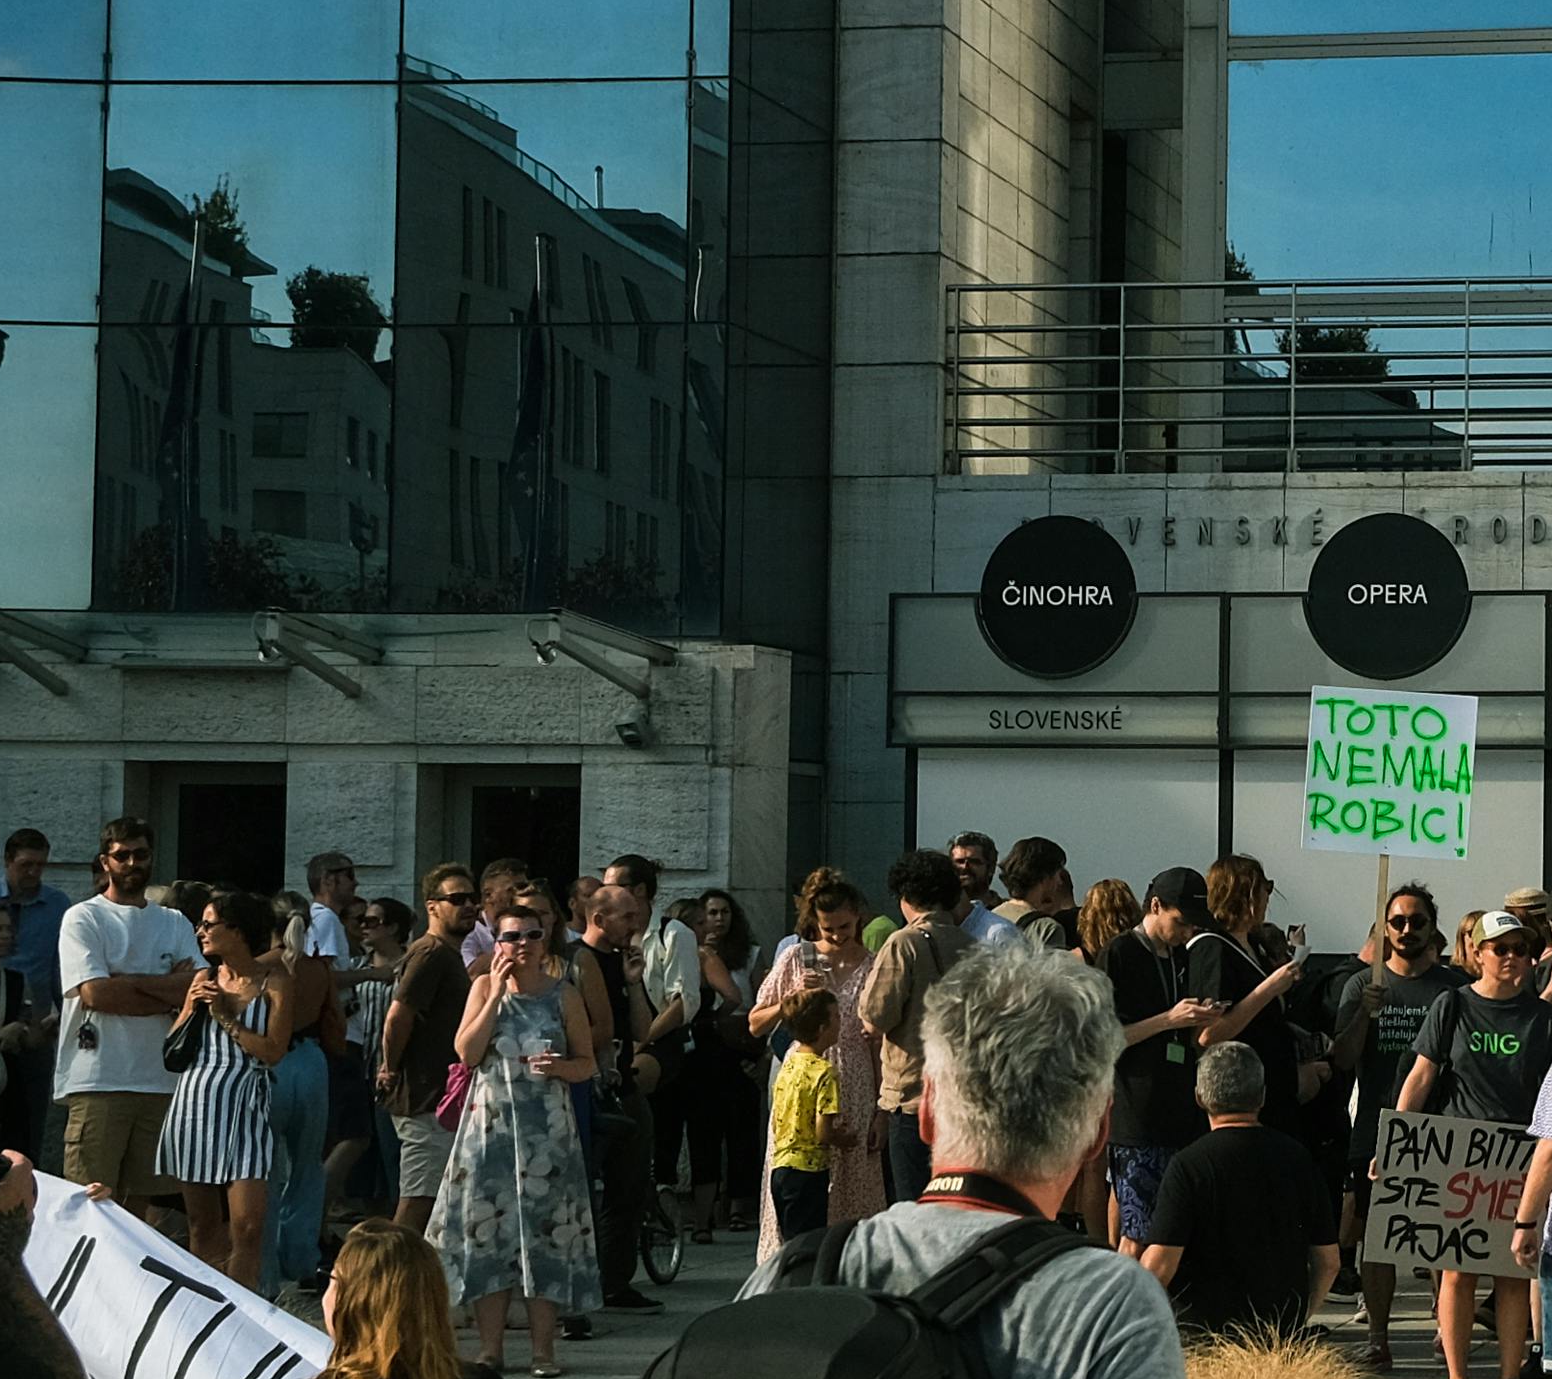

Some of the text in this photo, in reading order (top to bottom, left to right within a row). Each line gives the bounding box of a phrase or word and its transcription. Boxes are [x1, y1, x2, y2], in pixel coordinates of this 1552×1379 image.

[1021, 508, 1325, 547] VENSKÉ
[1001, 579, 1114, 607] ČINOHRA
[1348, 583, 1428, 605] OPERA
[989, 705, 1123, 731] SLOVENSKÉ
[1315, 698, 1447, 741] TOTO
[1312, 740, 1472, 794] NEMALA
[1469, 1031, 1521, 1055] SNG
[1382, 1117, 1454, 1172] PÁN
[1374, 1171, 1526, 1221] STE SME
[1384, 1214, 1491, 1265] PAJÁC
